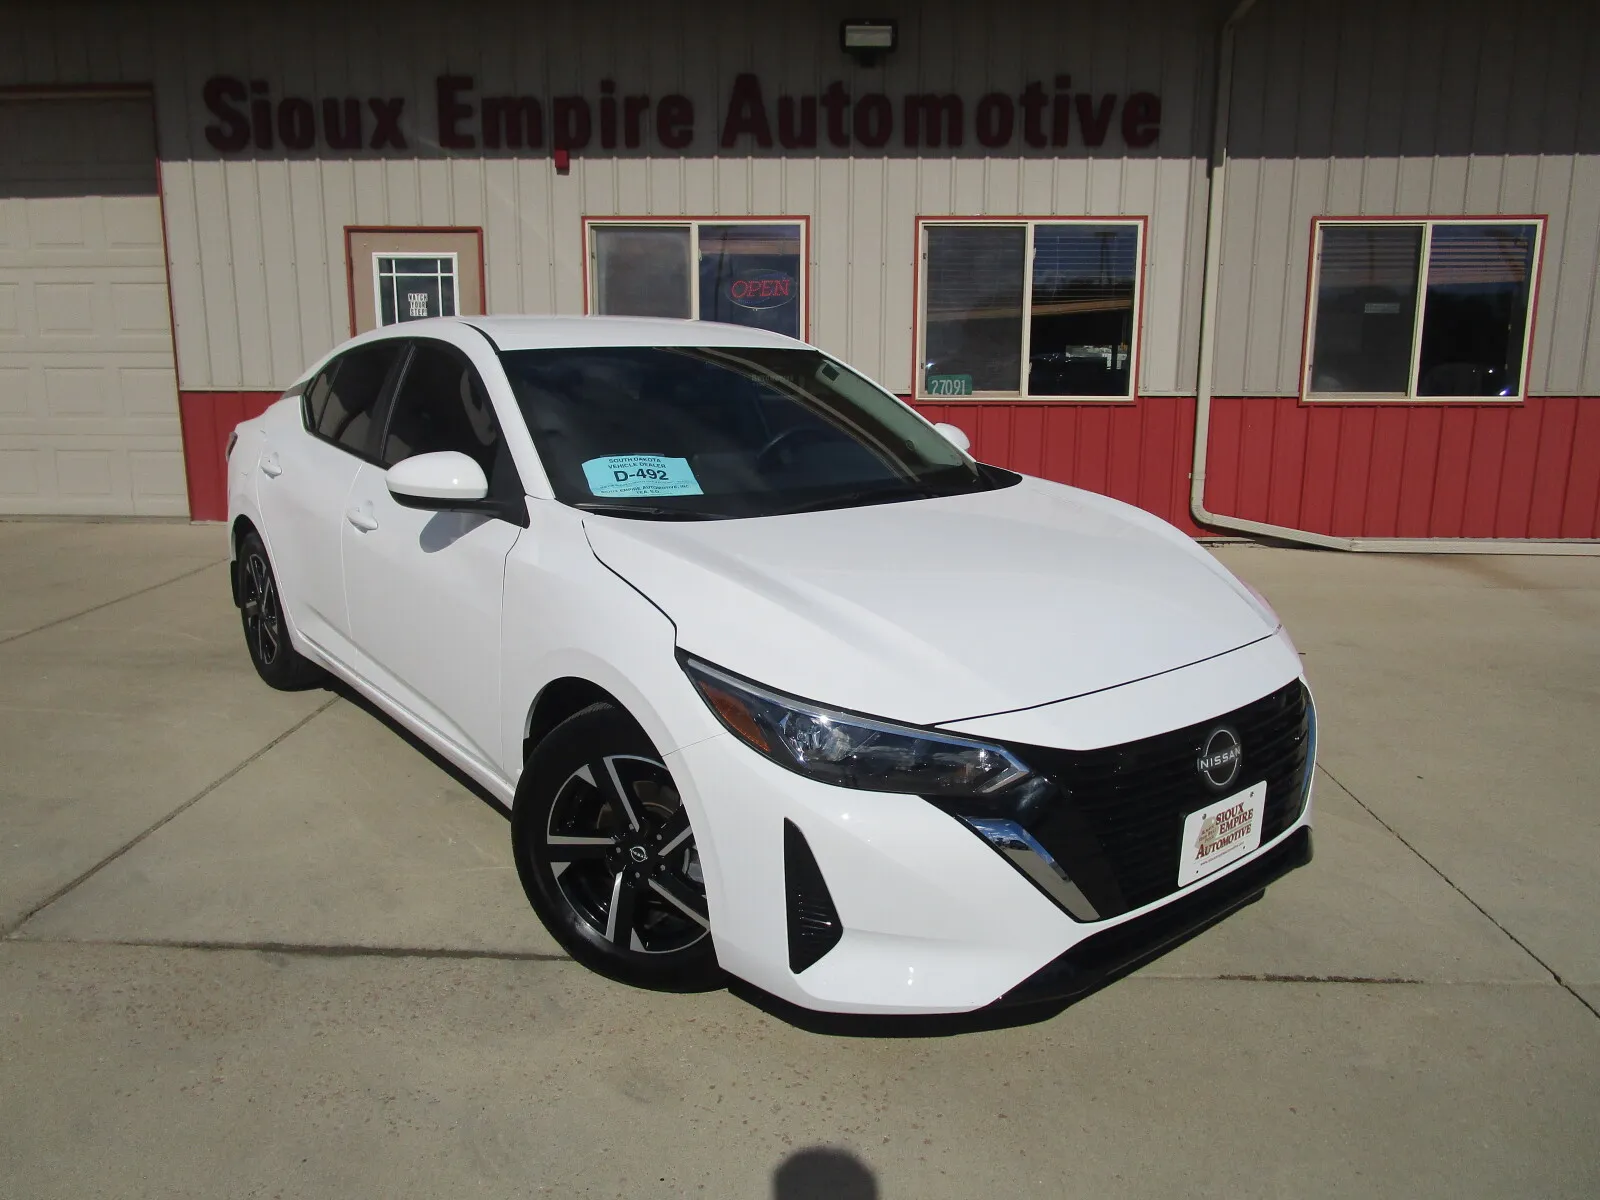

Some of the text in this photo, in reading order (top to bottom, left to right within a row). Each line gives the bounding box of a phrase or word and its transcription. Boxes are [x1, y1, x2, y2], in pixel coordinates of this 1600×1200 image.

[203, 73, 1162, 172] Sioux Empire Automotive
[731, 279, 790, 299] OPEN
[931, 379, 966, 396] 27091
[613, 468, 669, 482] D-492
[1200, 744, 1240, 770] NISSAN
[1215, 802, 1245, 826] SIOUX
[1219, 808, 1254, 835] EMPIRE
[1195, 823, 1252, 860] AUTOMOTIVE
